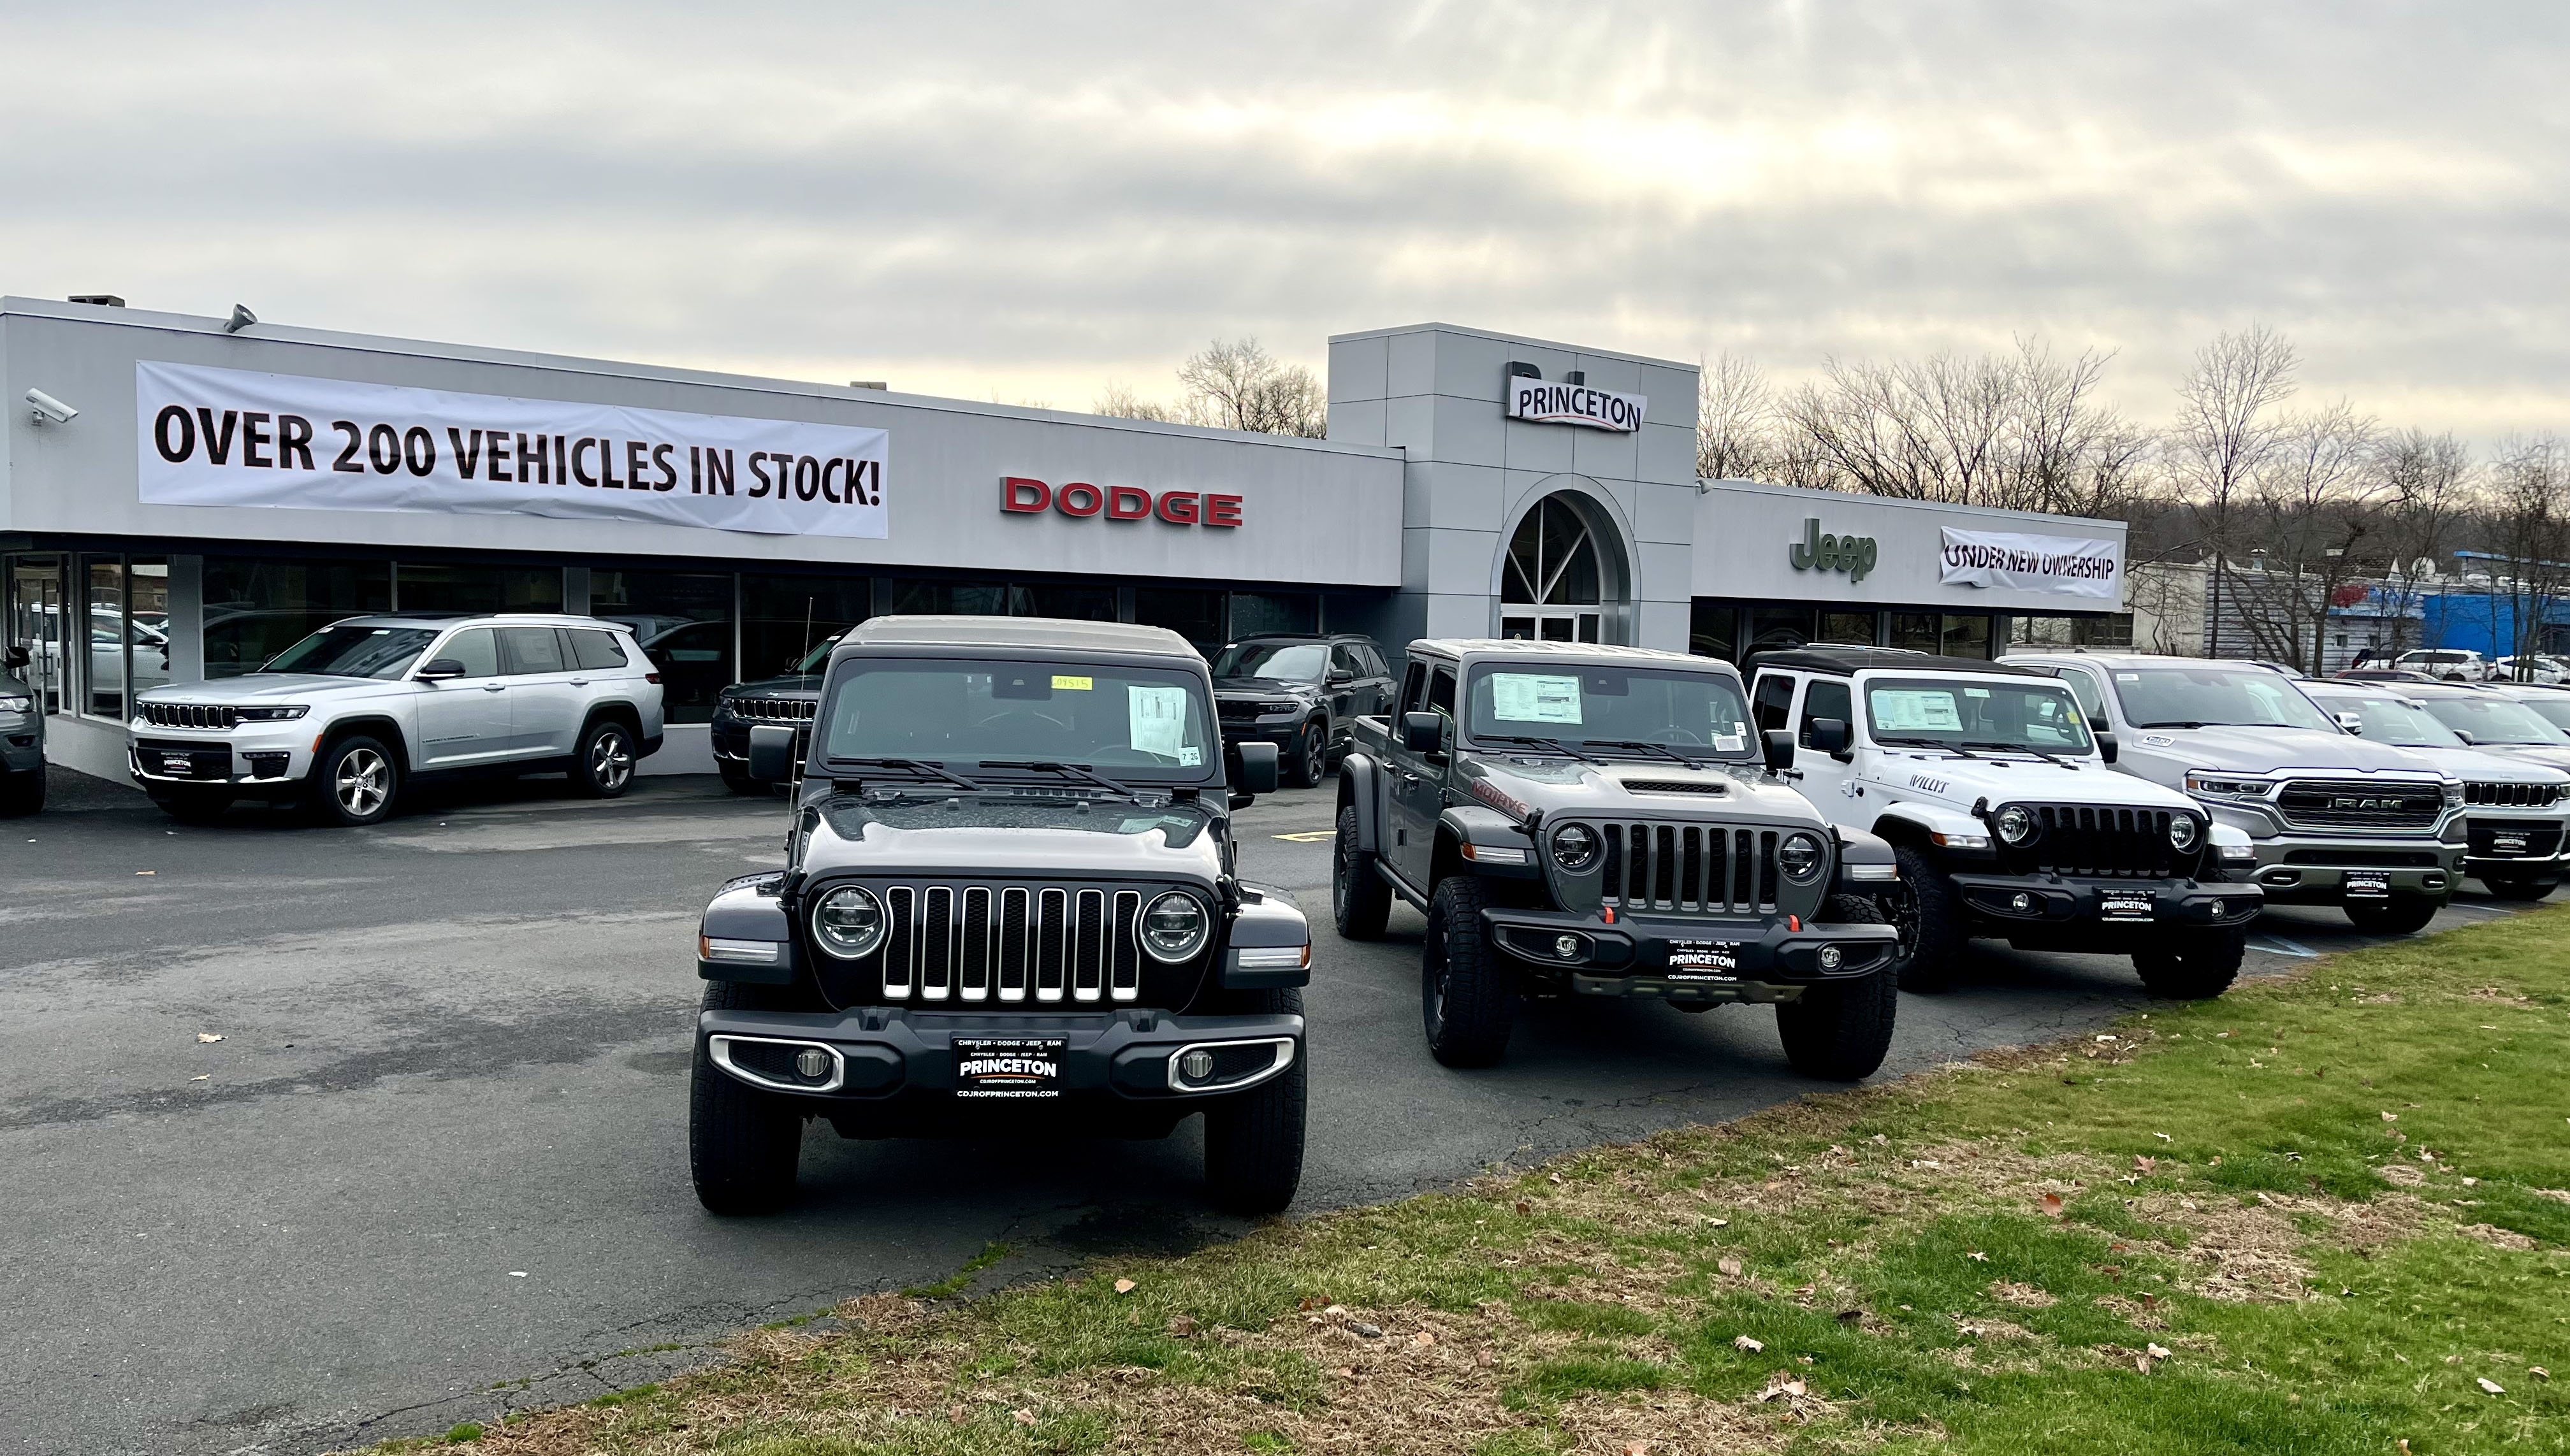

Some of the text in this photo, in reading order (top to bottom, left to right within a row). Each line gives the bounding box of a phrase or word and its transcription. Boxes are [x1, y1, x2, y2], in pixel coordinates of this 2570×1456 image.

[1519, 387, 1641, 433] PRINCETON
[154, 405, 880, 507] OVER 200 VEHICLES IN STOCK!
[999, 477, 1244, 527] DODGE
[1789, 518, 1877, 583] Jeep
[1944, 544, 2115, 580] UNDER NEW OWNERSHIP
[1909, 774, 1950, 793] WILLYS
[1472, 781, 1529, 816] MOJAVE
[2335, 798, 2402, 809] RAM
[2346, 881, 2387, 890] PRINCETON
[2102, 900, 2152, 911] PRINCETON
[1669, 954, 1736, 968] PRINCETON
[960, 1058, 1057, 1078] PRINCETON
